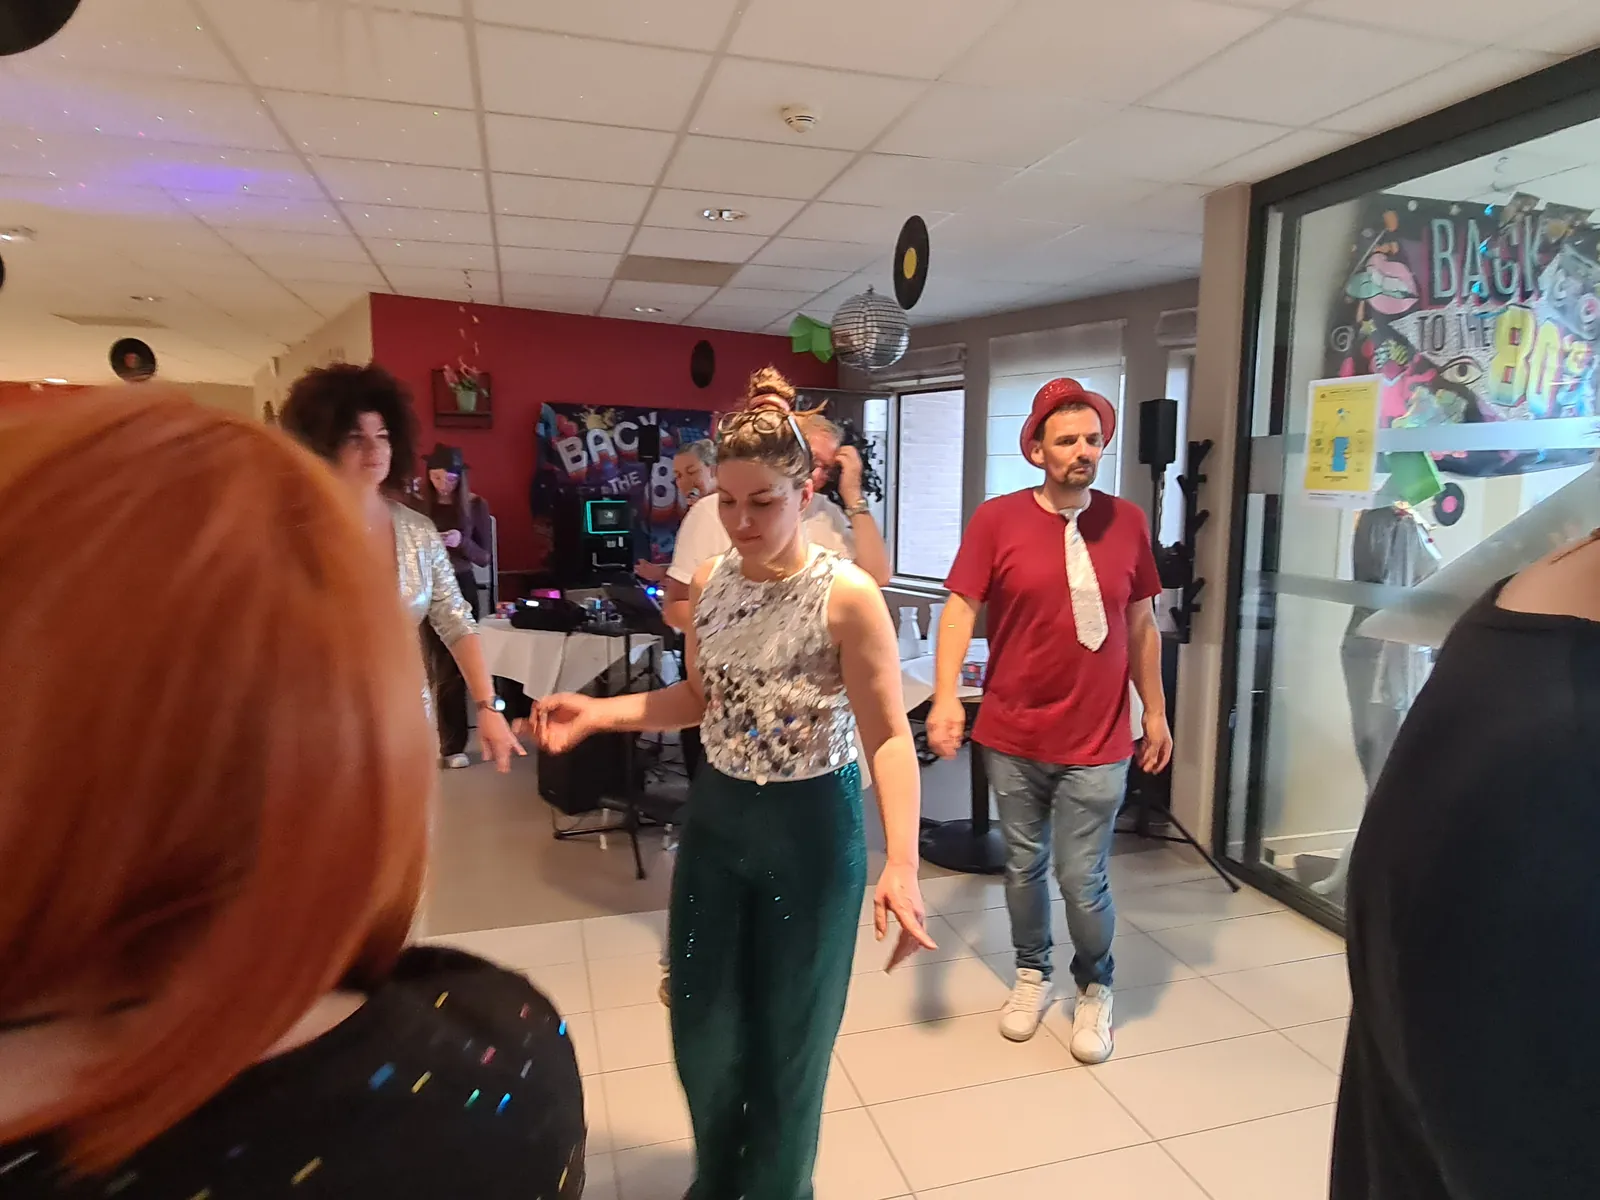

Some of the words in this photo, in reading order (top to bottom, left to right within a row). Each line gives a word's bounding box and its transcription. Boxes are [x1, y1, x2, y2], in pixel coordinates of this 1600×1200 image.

[1431, 214, 1543, 298] BACK
[1413, 314, 1445, 352] TO
[607, 471, 642, 495] THE
